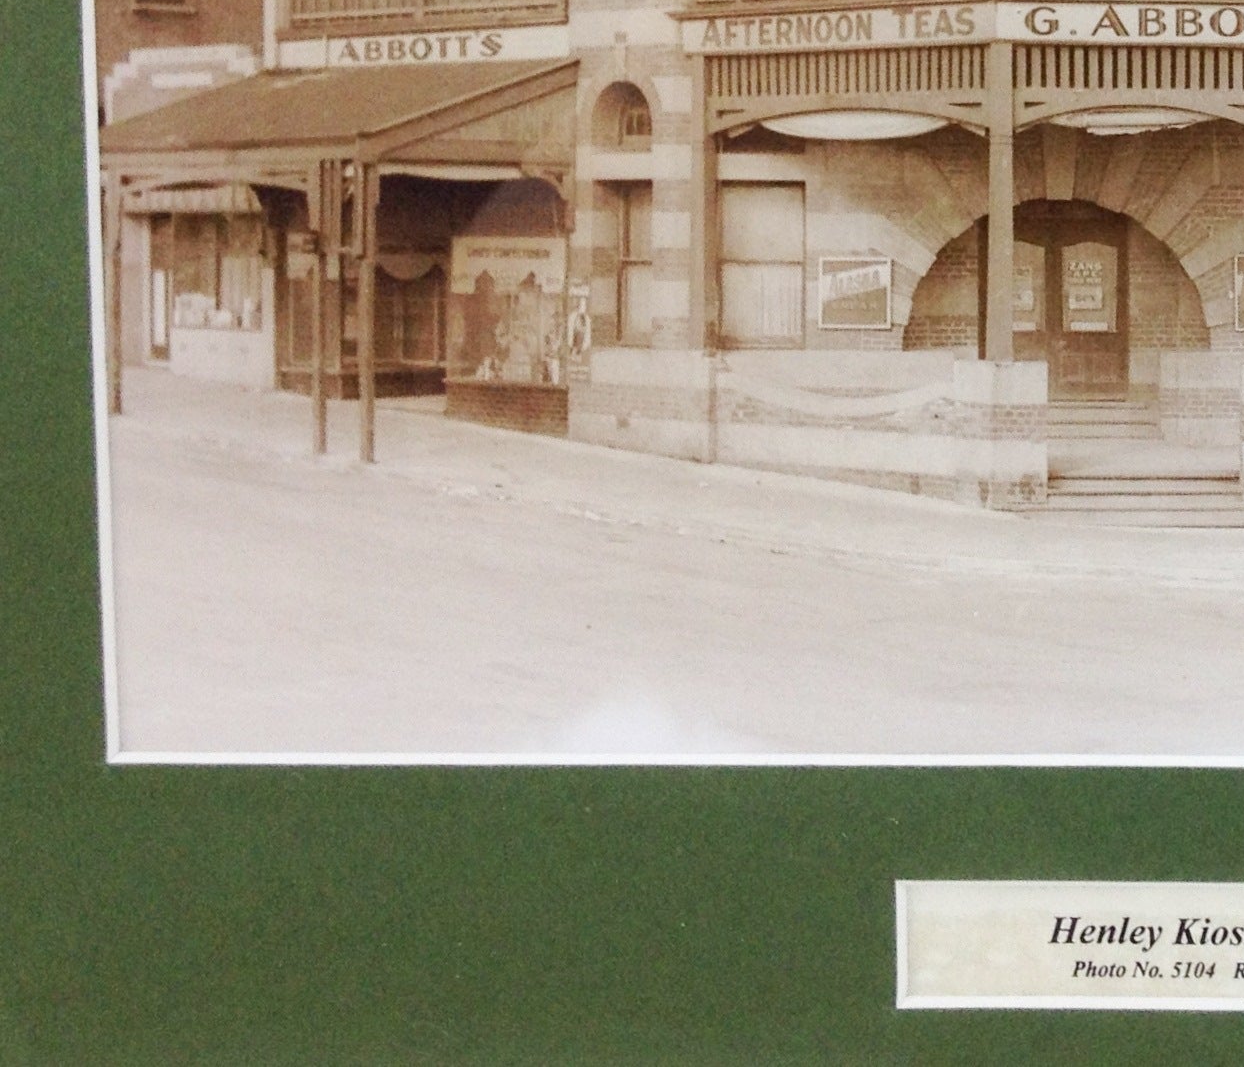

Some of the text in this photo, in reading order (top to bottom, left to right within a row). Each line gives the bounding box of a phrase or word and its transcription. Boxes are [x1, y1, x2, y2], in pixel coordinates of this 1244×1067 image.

[701, 6, 976, 48] AFTERNOON TEAS
[338, 33, 503, 62] ABBOTT'S
[1048, 916, 1163, 953] Henley
[1072, 961, 1127, 979] Photo
[1133, 961, 1164, 979] No.
[1172, 961, 1216, 980] 5104
